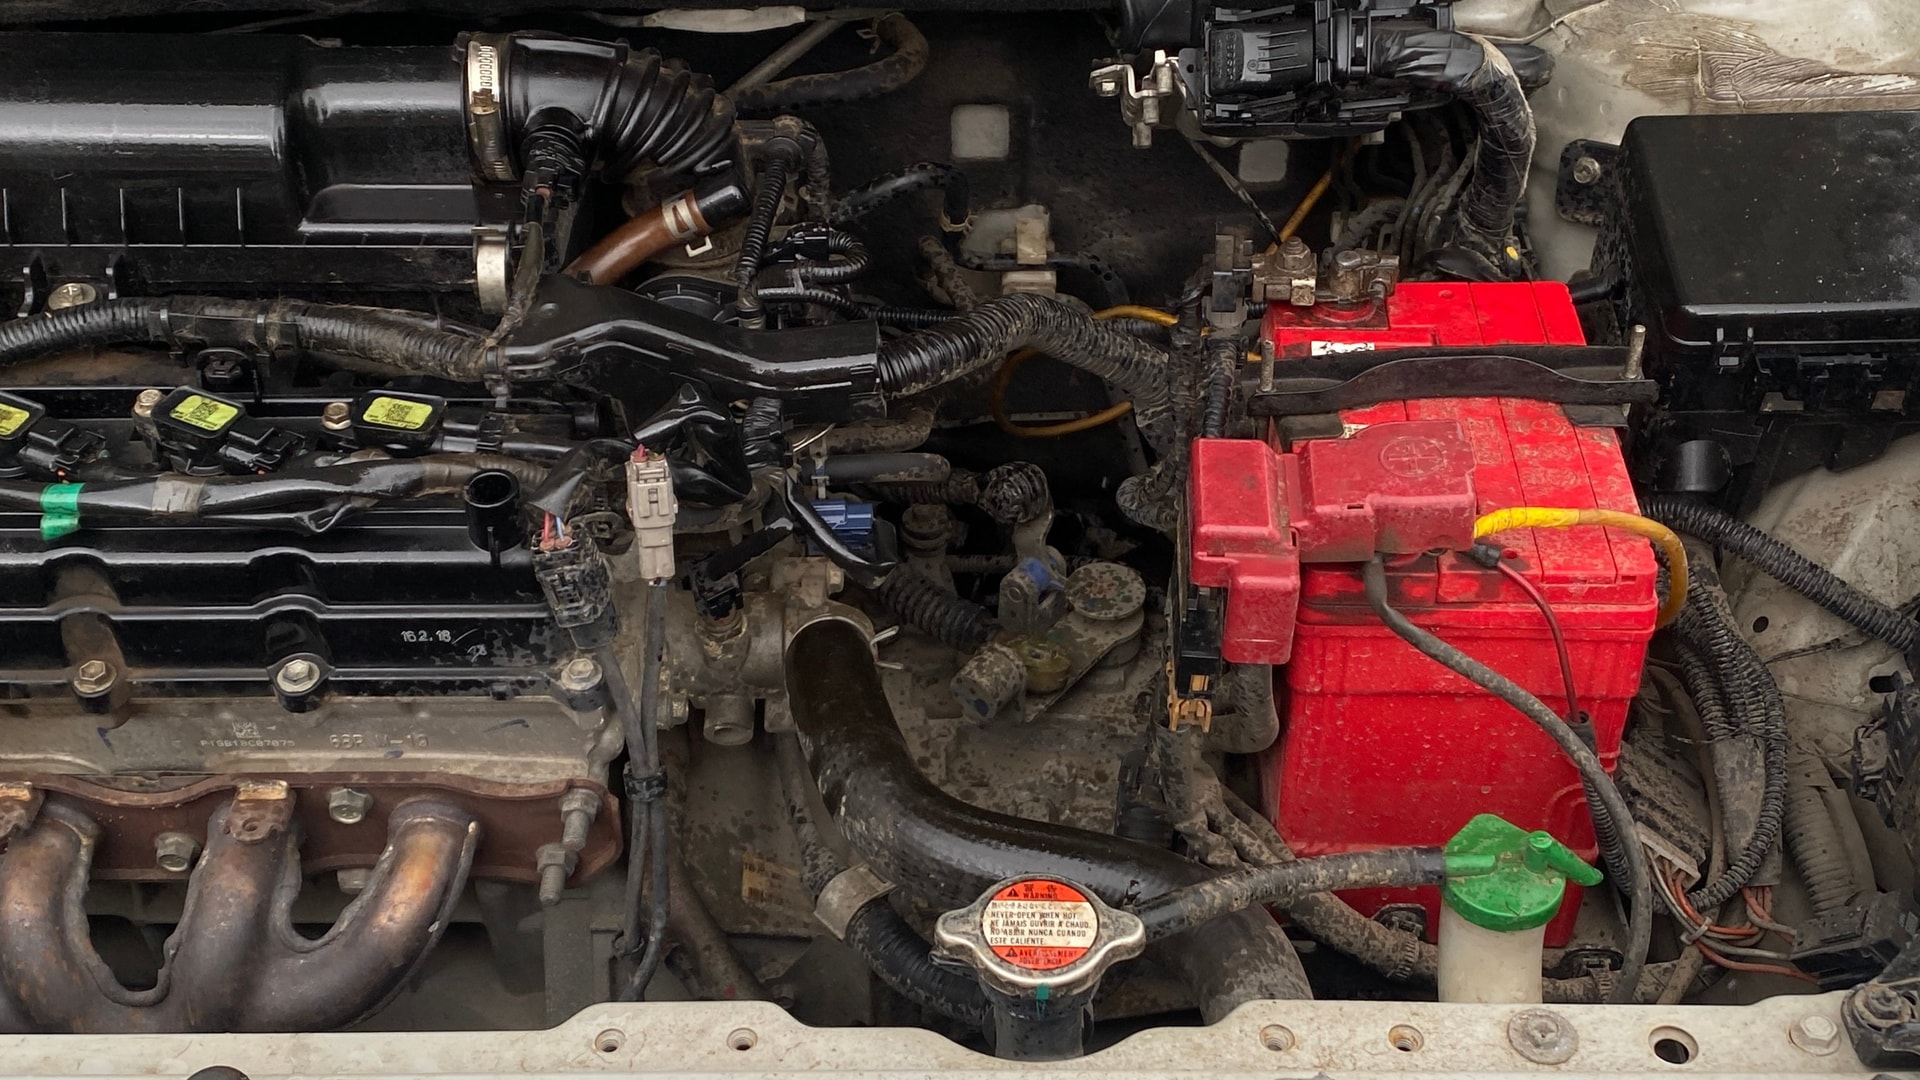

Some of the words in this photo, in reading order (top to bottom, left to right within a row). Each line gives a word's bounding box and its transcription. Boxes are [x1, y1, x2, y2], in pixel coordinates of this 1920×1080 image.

[1002, 920, 1027, 928] JAMAIS
[1030, 920, 1055, 928] OUVRIR
[1028, 929, 1053, 937] NUNCA
[1056, 929, 1087, 938] CUANDO
[990, 936, 1007, 945] ESTE
